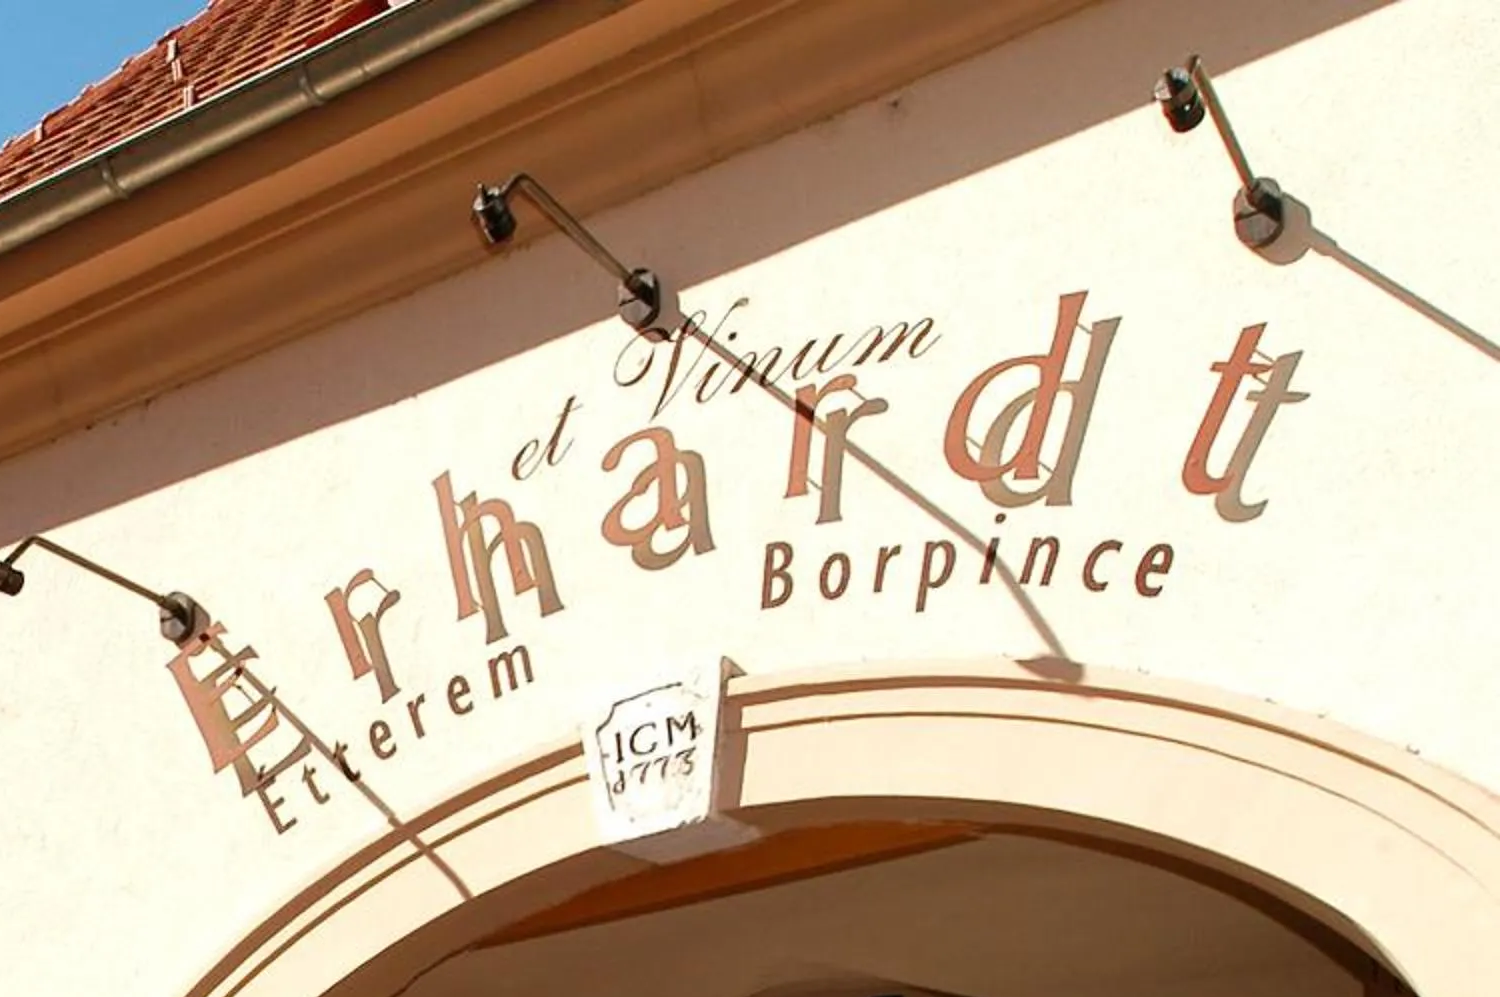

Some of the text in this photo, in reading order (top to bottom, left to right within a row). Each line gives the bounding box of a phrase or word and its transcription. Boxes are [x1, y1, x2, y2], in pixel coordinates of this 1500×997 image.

[511, 296, 942, 481] et Vinum
[166, 289, 1311, 798] Erhardt
[760, 512, 1175, 613] Borpince
